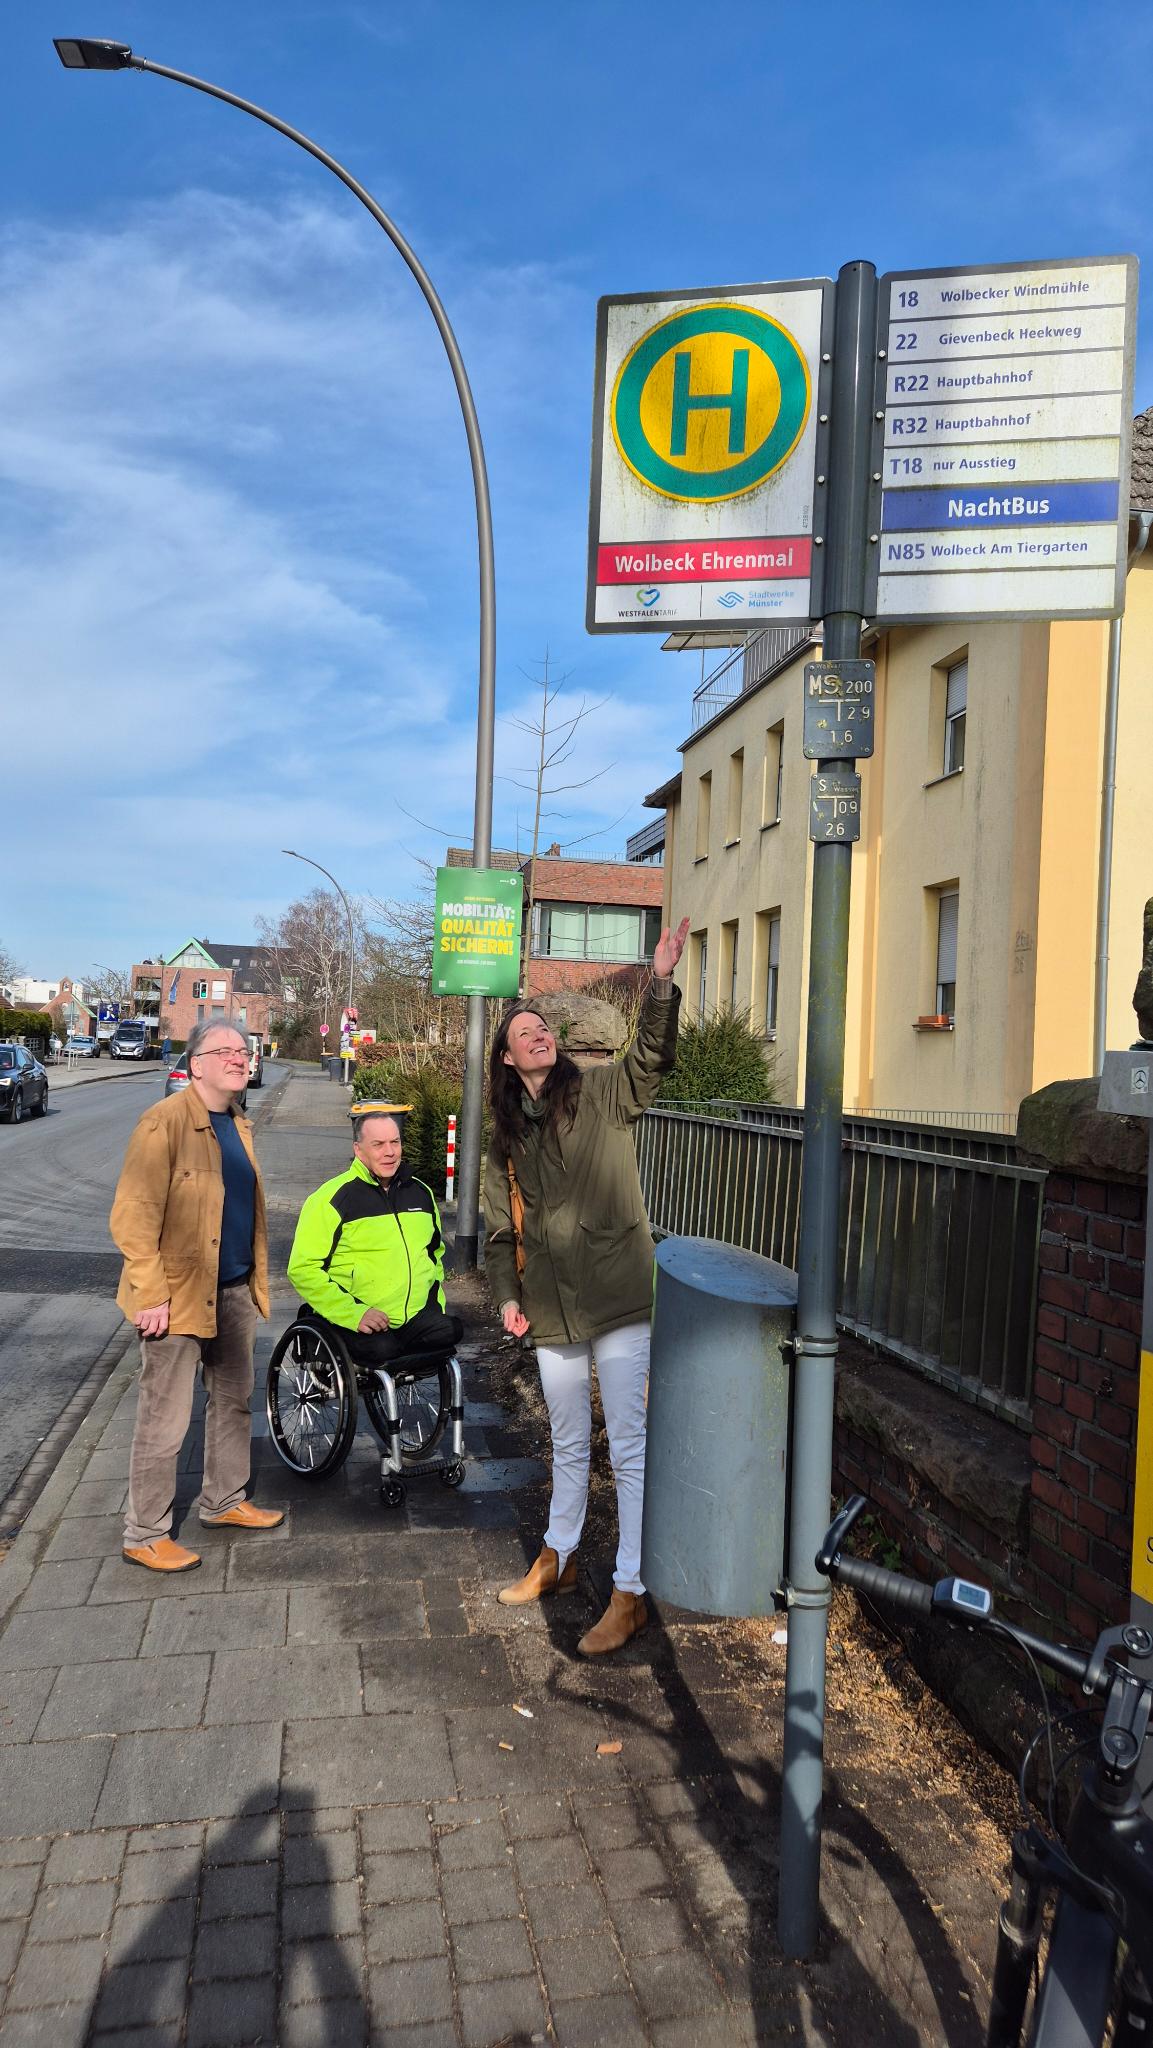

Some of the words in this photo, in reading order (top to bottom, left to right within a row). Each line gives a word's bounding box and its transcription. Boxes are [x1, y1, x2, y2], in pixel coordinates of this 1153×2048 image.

[898, 290, 919, 308] 18
[940, 287, 1010, 302] Wolbecker
[1013, 281, 1090, 297] Windmühle
[895, 333, 918, 350] 22
[938, 328, 1015, 345] Gievenbeck
[1019, 325, 1082, 340] Heekweg
[894, 374, 929, 393] R22
[936, 370, 1034, 389] Hauptbahnhof
[670, 348, 750, 457] H
[892, 416, 928, 435] R32
[935, 413, 1032, 432] Hauptbahnhof
[890, 457, 923, 475] T18
[933, 459, 955, 471] nur
[958, 456, 1017, 470] Ausstieg
[947, 497, 1050, 518] NachtBus
[614, 552, 696, 573] Wolbeck
[701, 547, 794, 571] Ehrenmal
[887, 543, 925, 561] N85
[931, 543, 986, 557] Wolbeck
[990, 543, 1013, 555] Am
[1017, 541, 1088, 554] Tiergarten
[748, 599, 784, 608] Münster
[809, 674, 840, 696] MS
[845, 680, 873, 694] 200
[441, 902, 516, 920] MOBILITÄT:
[441, 918, 516, 938] QUALITÄT
[440, 937, 514, 956] SICHERN!
